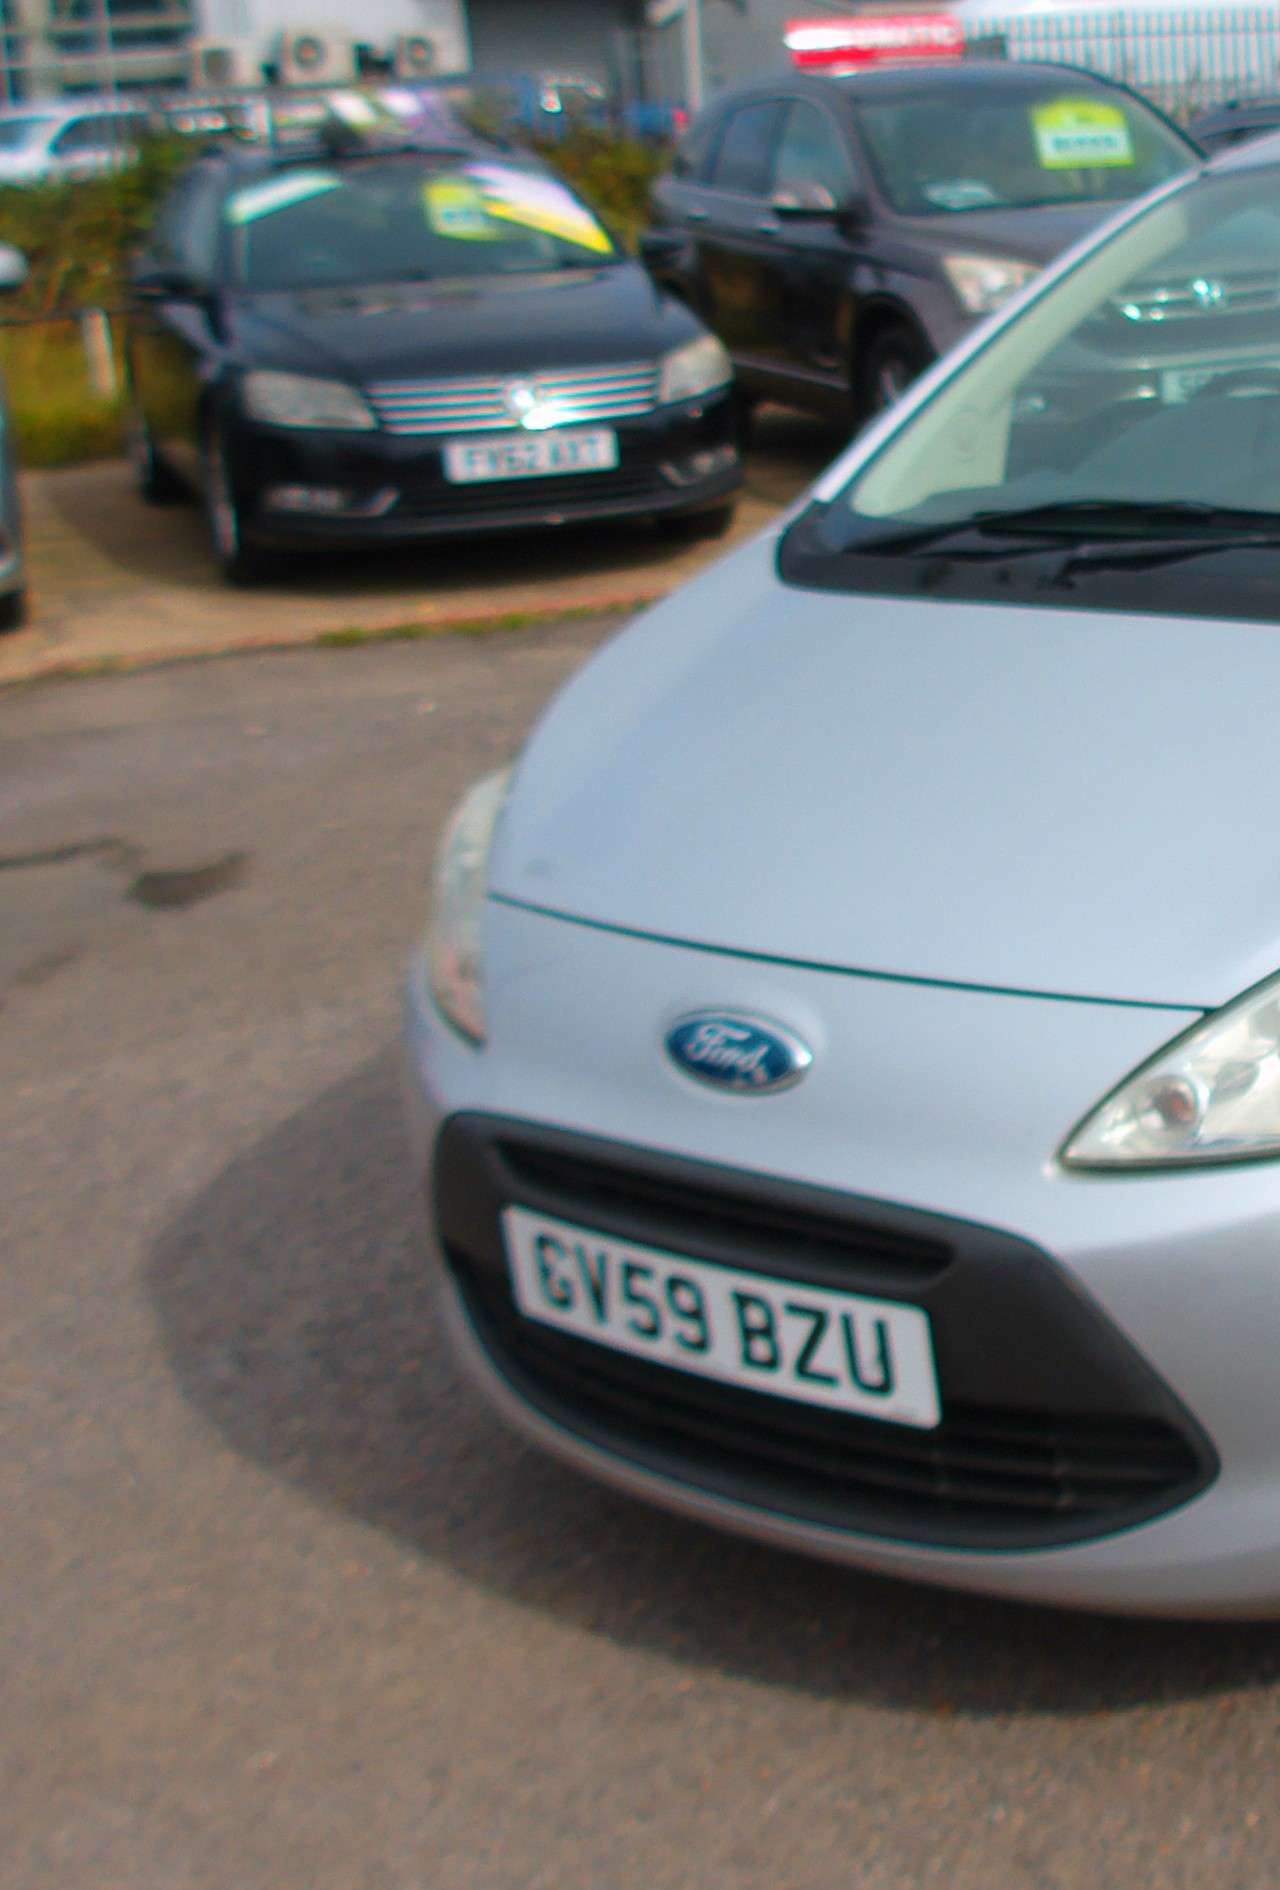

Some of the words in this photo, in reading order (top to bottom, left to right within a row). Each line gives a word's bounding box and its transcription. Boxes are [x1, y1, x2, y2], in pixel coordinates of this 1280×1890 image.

[687, 1023, 768, 1073] Ford
[534, 1232, 712, 1353] GV59
[730, 1287, 896, 1399] BZU
